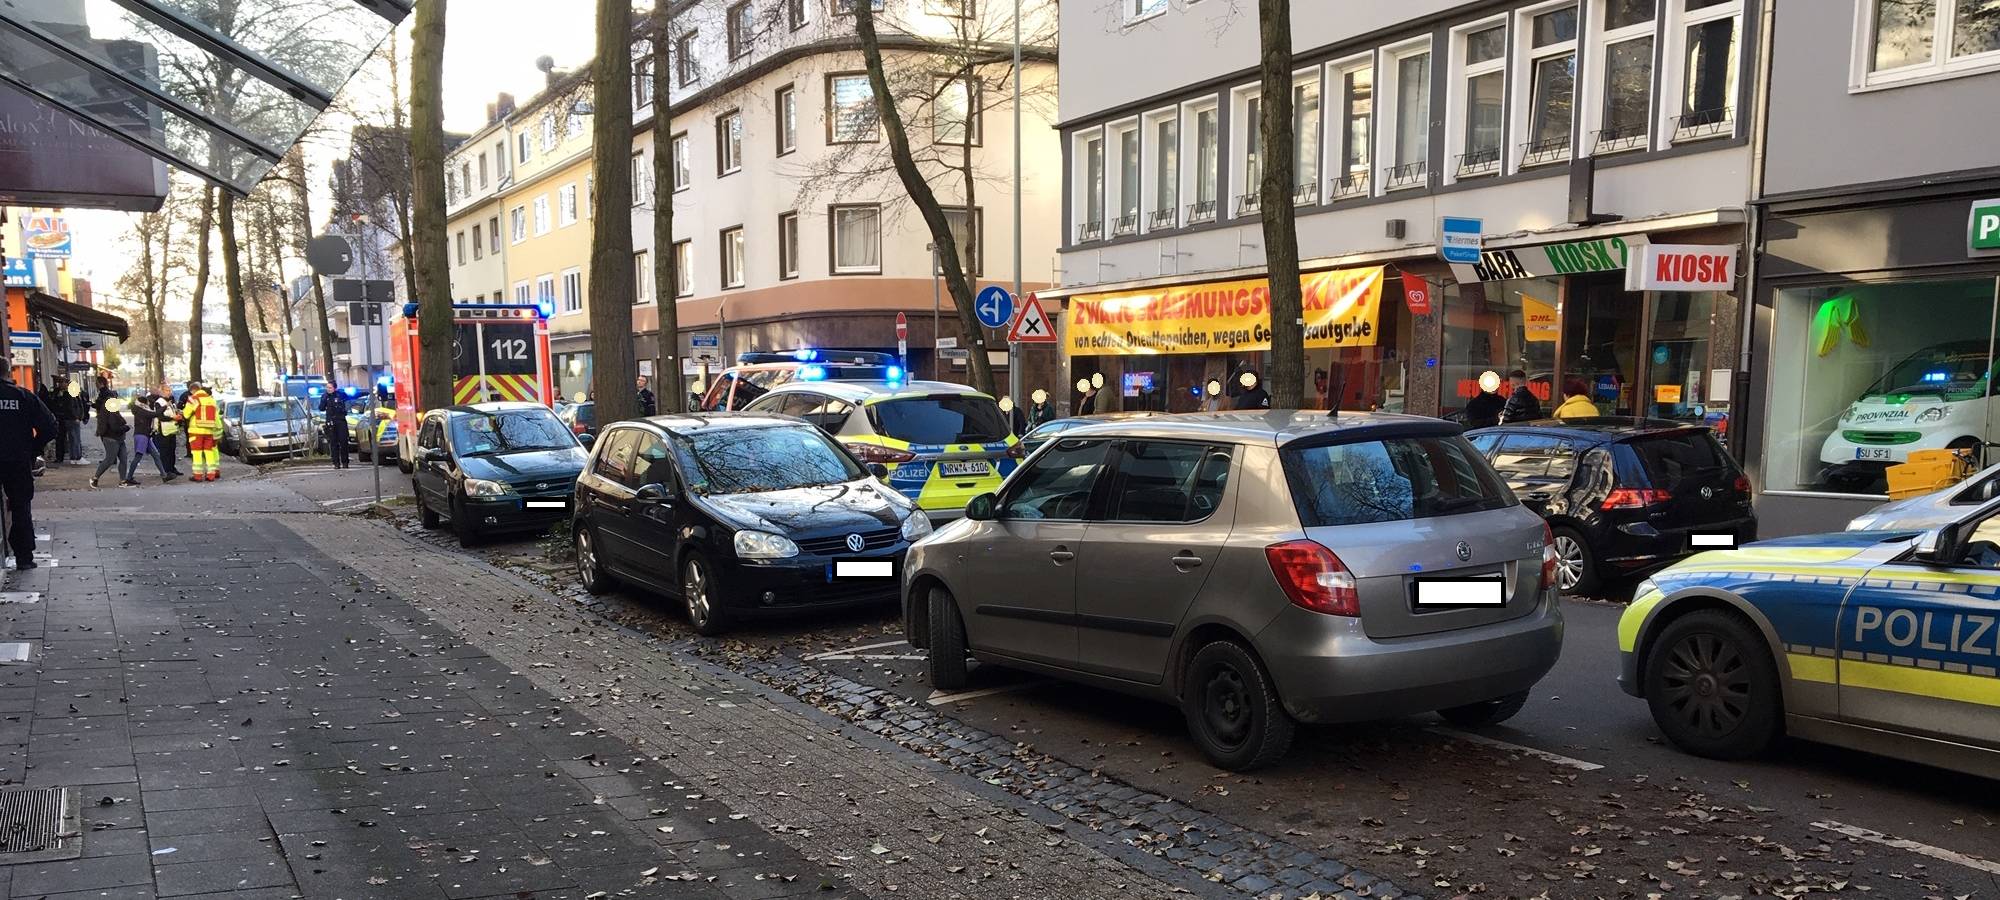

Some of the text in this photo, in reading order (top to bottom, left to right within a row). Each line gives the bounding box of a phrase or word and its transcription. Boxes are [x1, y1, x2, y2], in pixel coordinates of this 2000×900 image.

[1980, 214, 2000, 240] P
[1453, 235, 1479, 245] Hermes
[1473, 249, 1528, 281] BABA
[1544, 240, 1617, 273] KIOSK
[1656, 254, 1730, 283] KIOSK
[1074, 335, 1089, 348] von
[1092, 331, 1123, 348] echten
[1213, 328, 1250, 348] wegen
[491, 339, 528, 360] 112
[0, 399, 19, 410] IZEI
[1855, 410, 1910, 421] PROVINZIAL
[890, 468, 928, 479] POLIZEI
[944, 462, 959, 474] NRW
[1855, 606, 2000, 656] POLIZ
